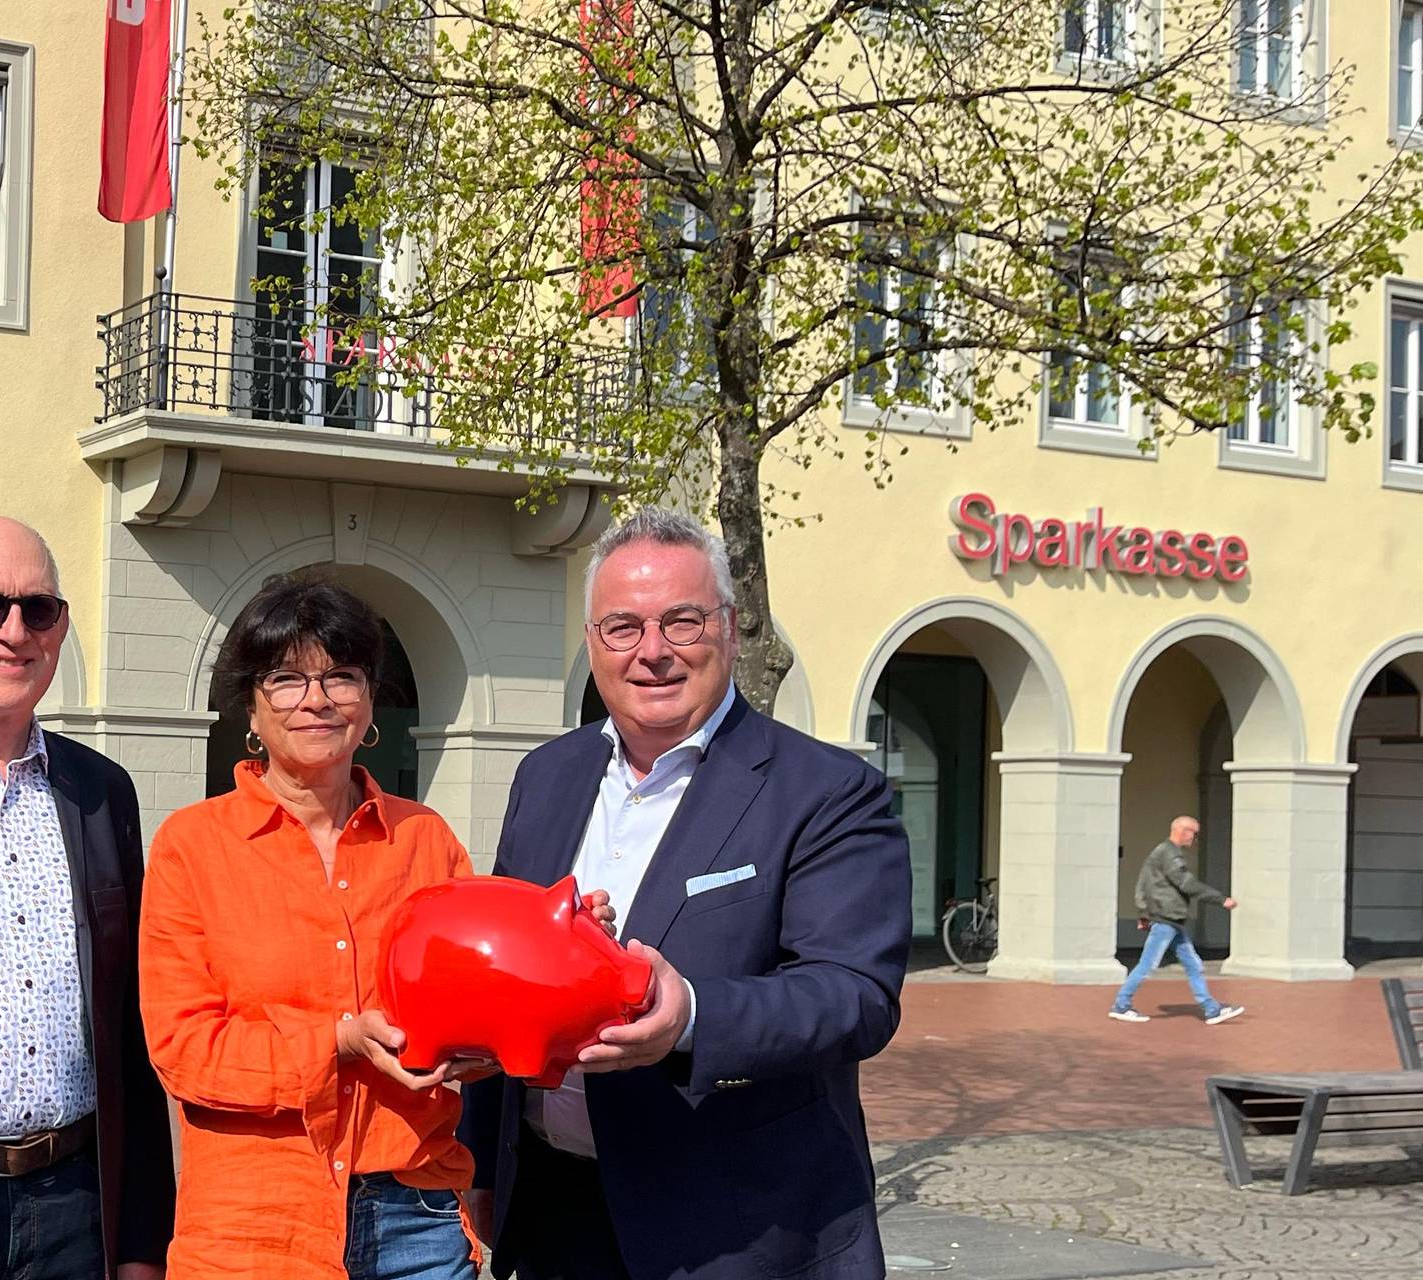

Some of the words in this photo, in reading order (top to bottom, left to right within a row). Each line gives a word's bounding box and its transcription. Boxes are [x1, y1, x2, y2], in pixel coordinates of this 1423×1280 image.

[299, 327, 526, 386] SPARA
[348, 514, 357, 530] 3
[948, 493, 1249, 582] Sparkasse
